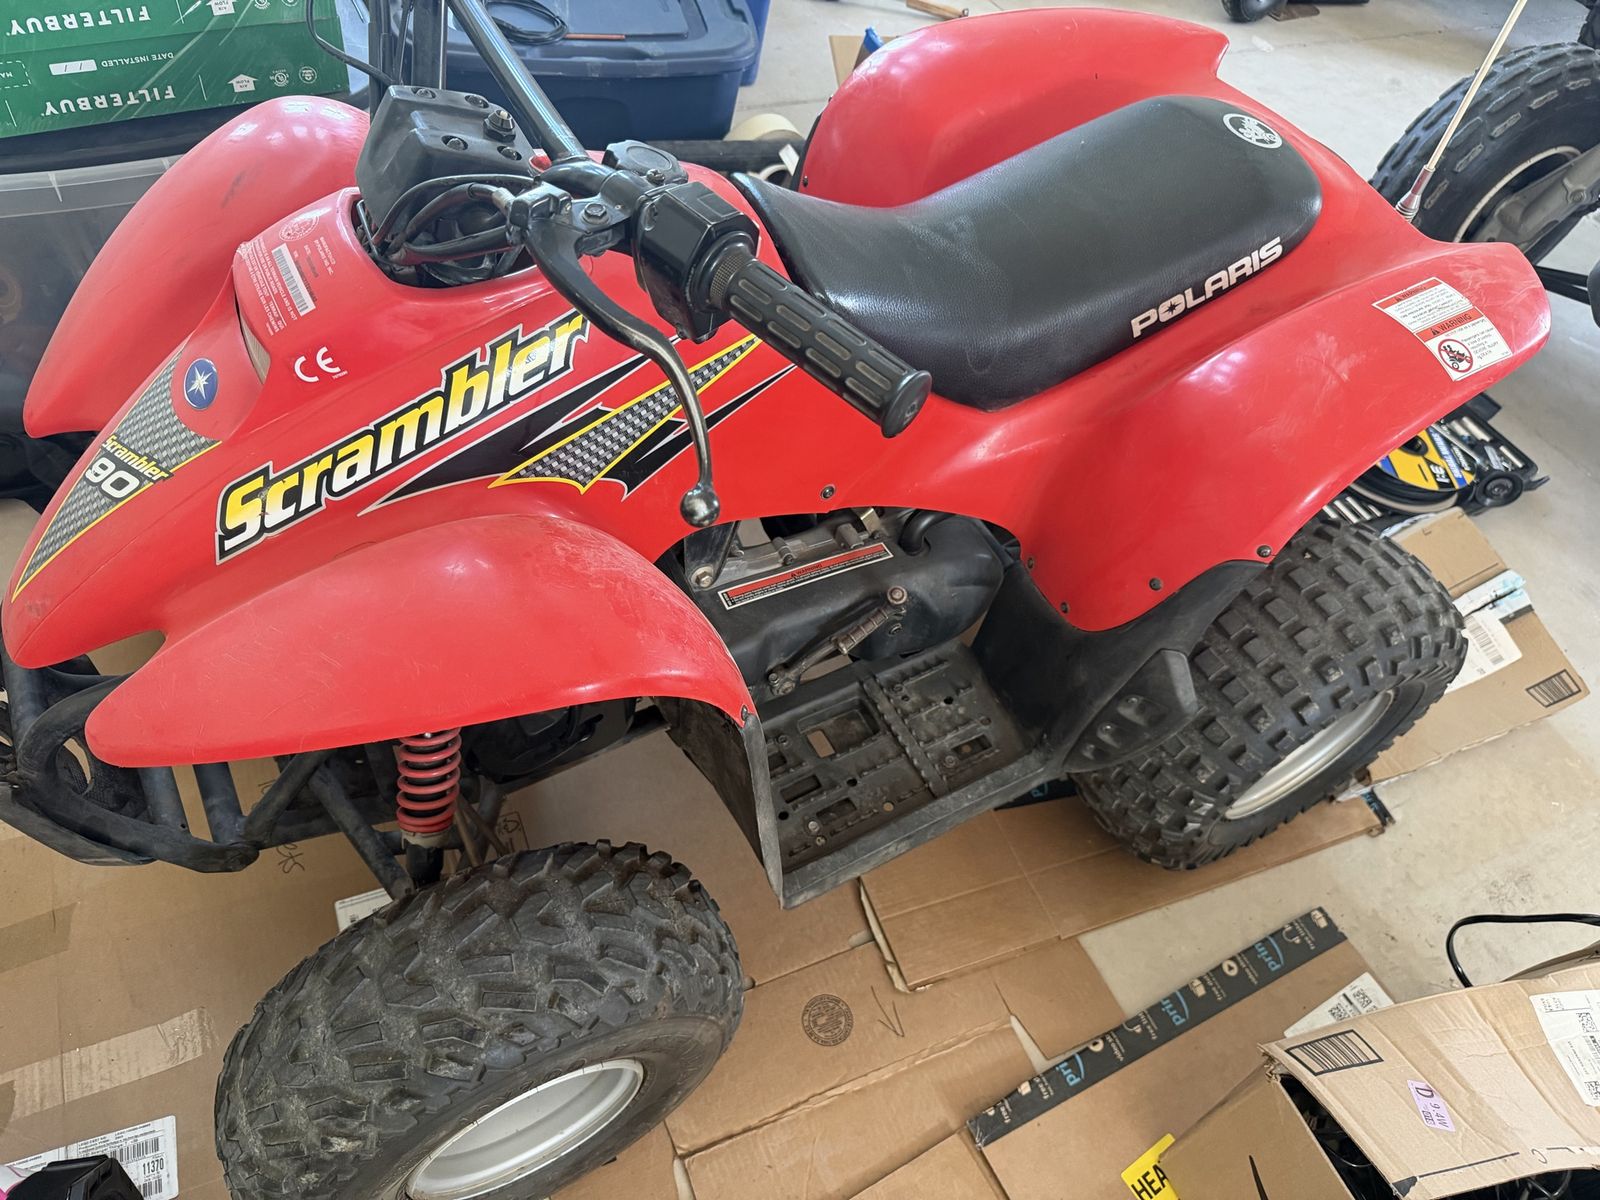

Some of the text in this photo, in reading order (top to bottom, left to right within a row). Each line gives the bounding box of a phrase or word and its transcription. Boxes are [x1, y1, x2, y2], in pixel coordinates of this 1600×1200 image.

[9, 5, 151, 36] FILTERBUY
[101, 52, 174, 67] DATE INSTALLED
[43, 85, 176, 116] FILTERBUY
[1131, 236, 1284, 340] POLARIS
[1439, 313, 1472, 331] WARNING
[293, 346, 341, 383] CE
[222, 311, 585, 553] Scrambler
[102, 434, 169, 481] Scrambler
[85, 457, 140, 499] 90
[1055, 1061, 1081, 1087] pri
[1415, 1086, 1435, 1099] D
[142, 1158, 165, 1175] 11370
[1131, 1164, 1168, 1200] HEA
